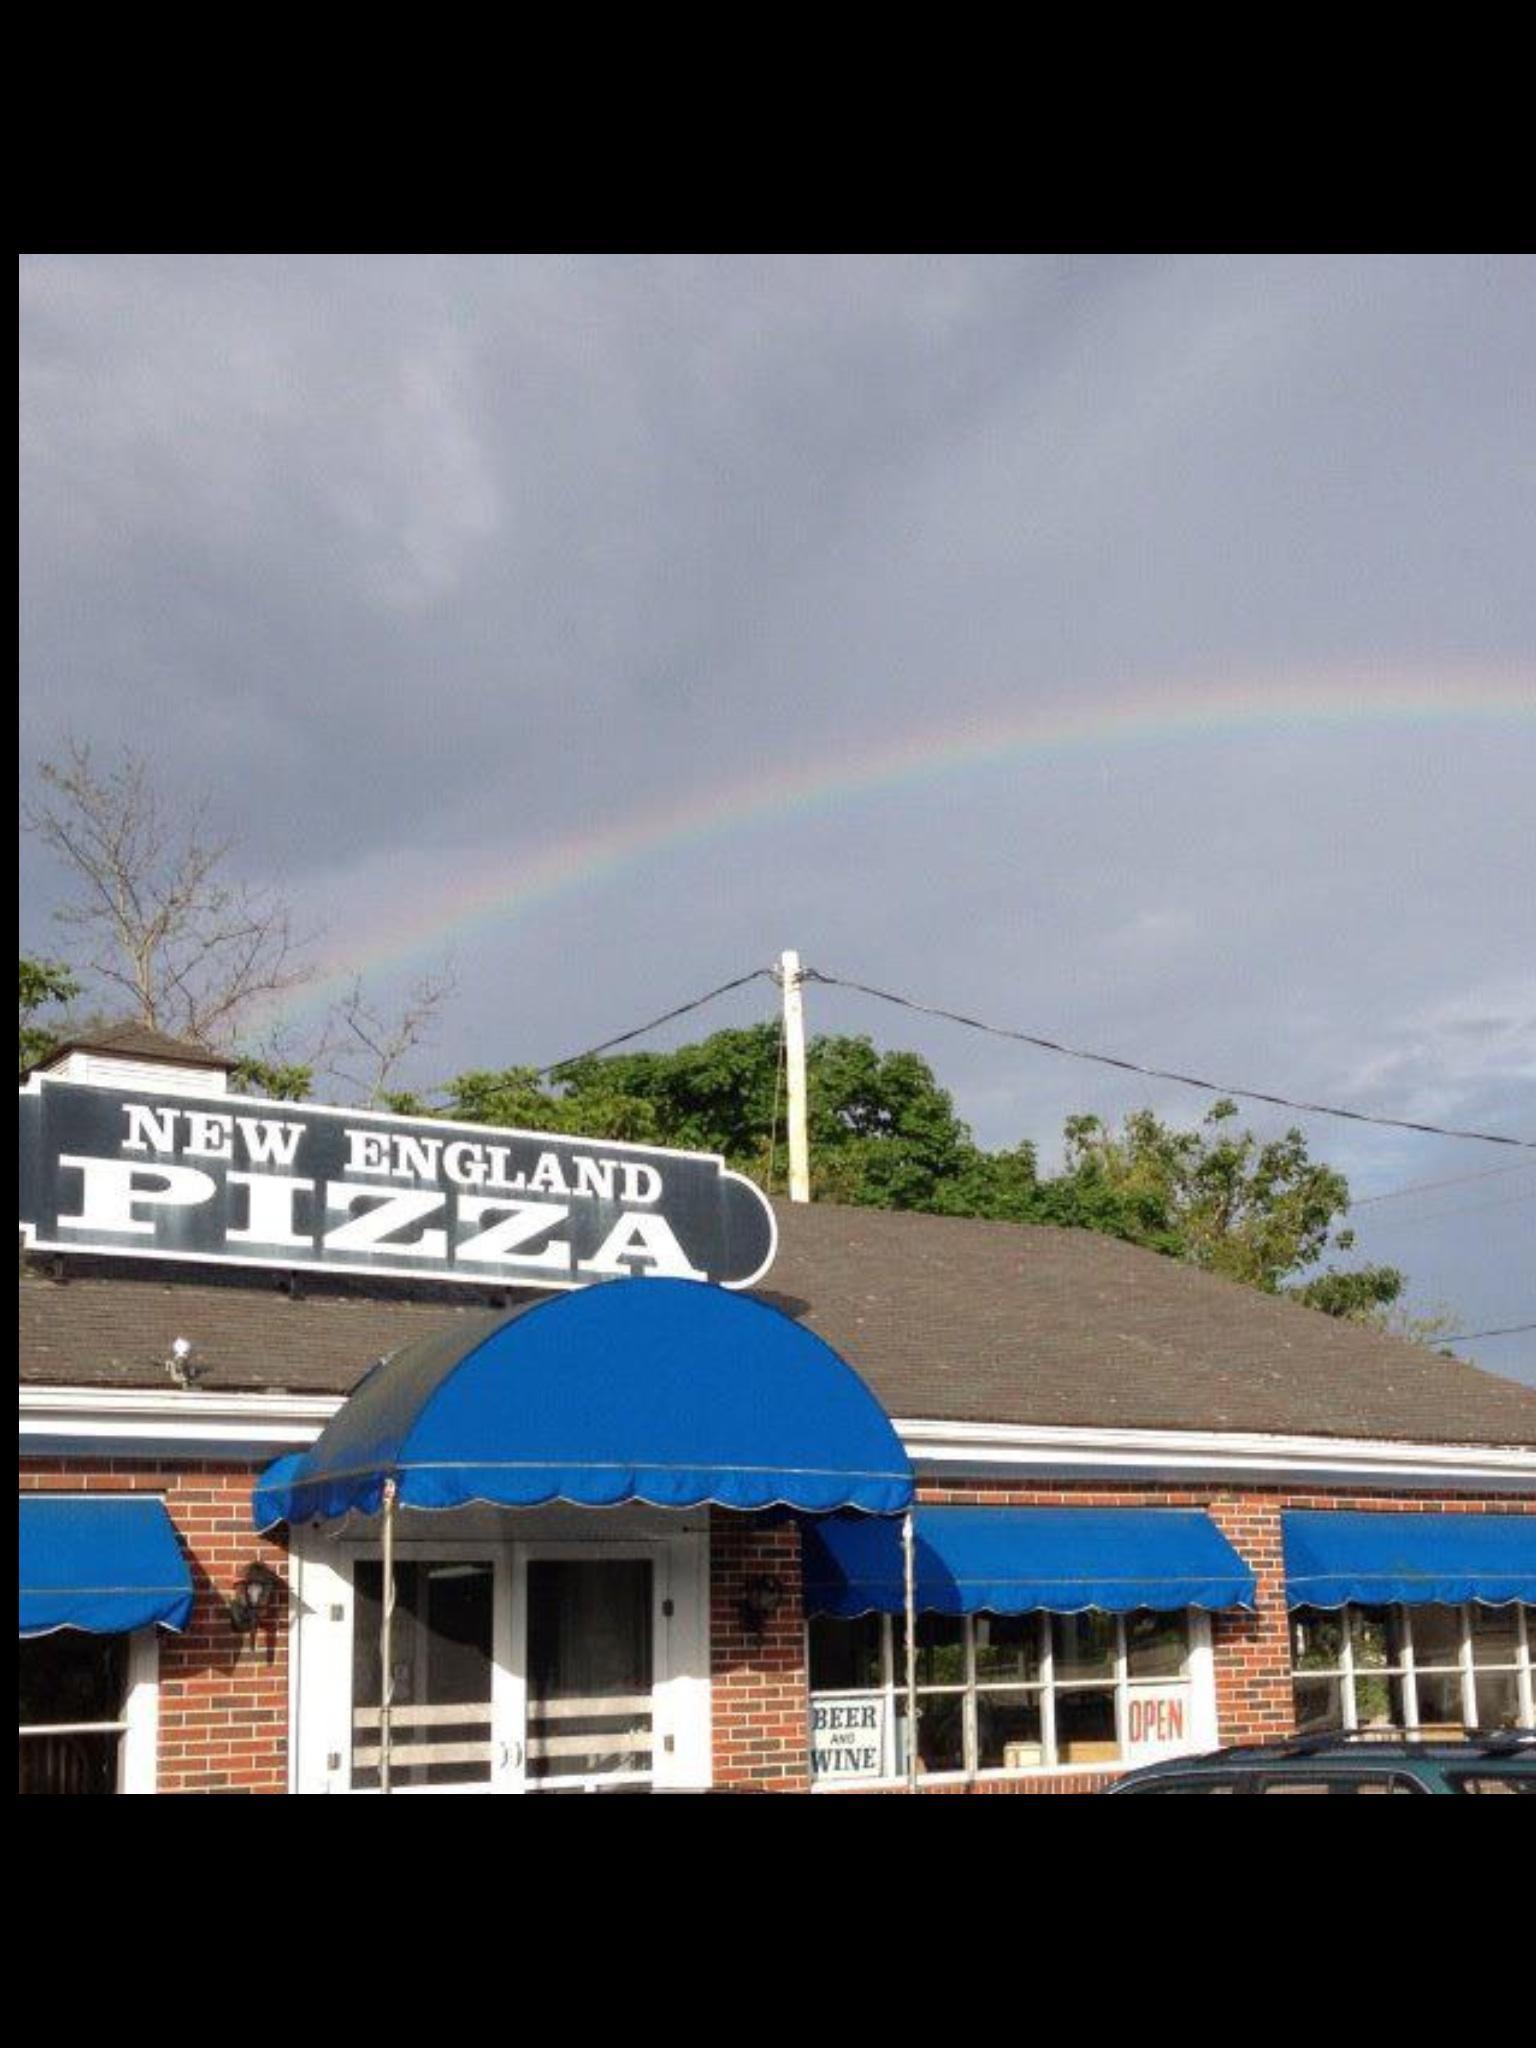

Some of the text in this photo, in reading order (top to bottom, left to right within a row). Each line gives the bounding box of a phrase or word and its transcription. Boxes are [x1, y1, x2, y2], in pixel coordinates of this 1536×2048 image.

[121, 1103, 663, 1203] NEW ENGLAND
[57, 1155, 708, 1280] PIZZA
[812, 1705, 877, 1730] BEER
[1128, 1699, 1183, 1743] OPEN
[830, 1732, 856, 1744] AND
[812, 1748, 877, 1773] WINE
